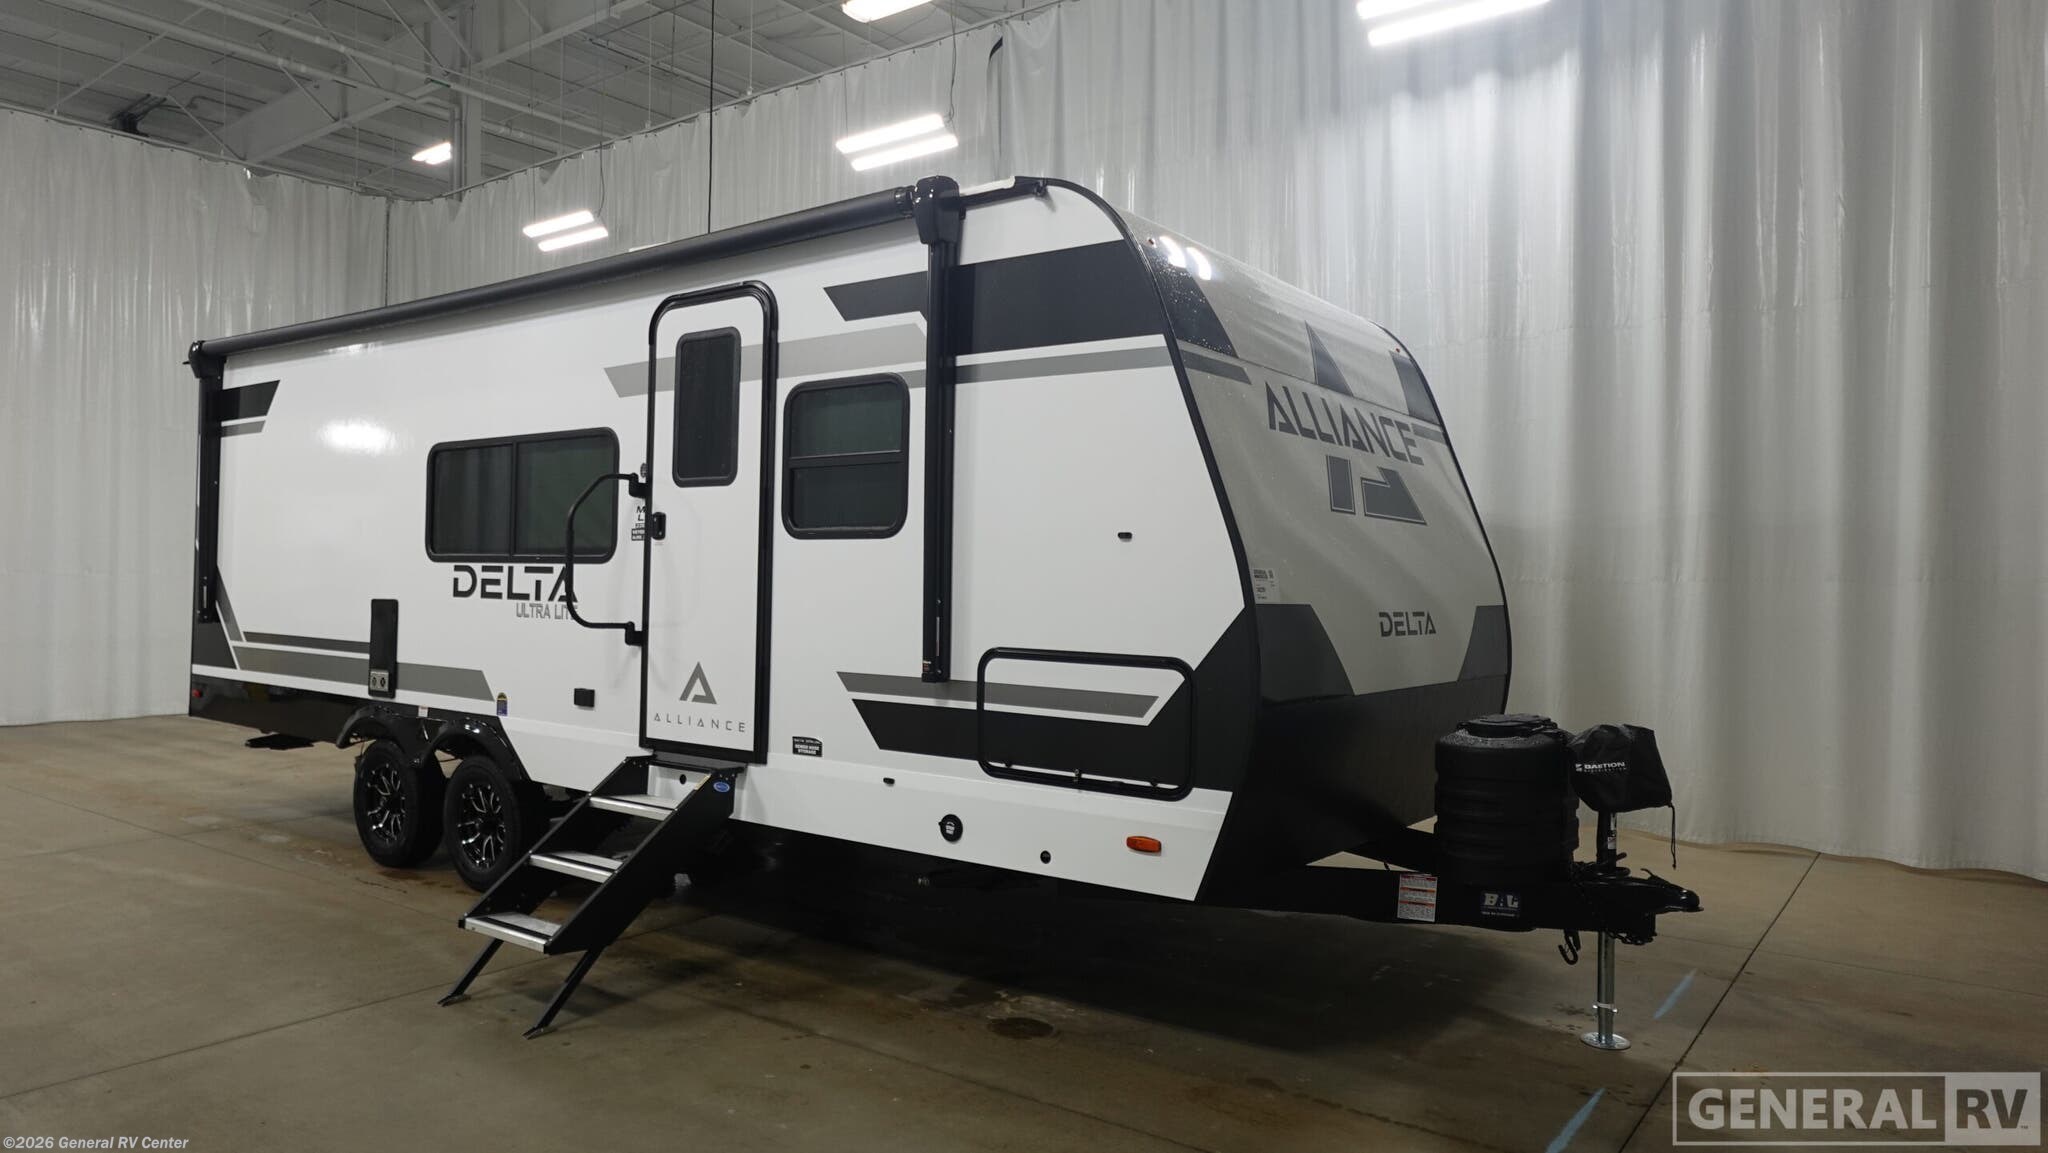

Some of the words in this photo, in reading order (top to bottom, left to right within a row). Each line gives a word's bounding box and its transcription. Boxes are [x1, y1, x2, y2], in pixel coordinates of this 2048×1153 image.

[1265, 381, 1425, 466] ALLIANCE
[453, 564, 578, 602] DELTA
[516, 602, 550, 619] ULTRA
[1379, 611, 1436, 637] DELTA
[654, 712, 745, 732] ALLIANCE
